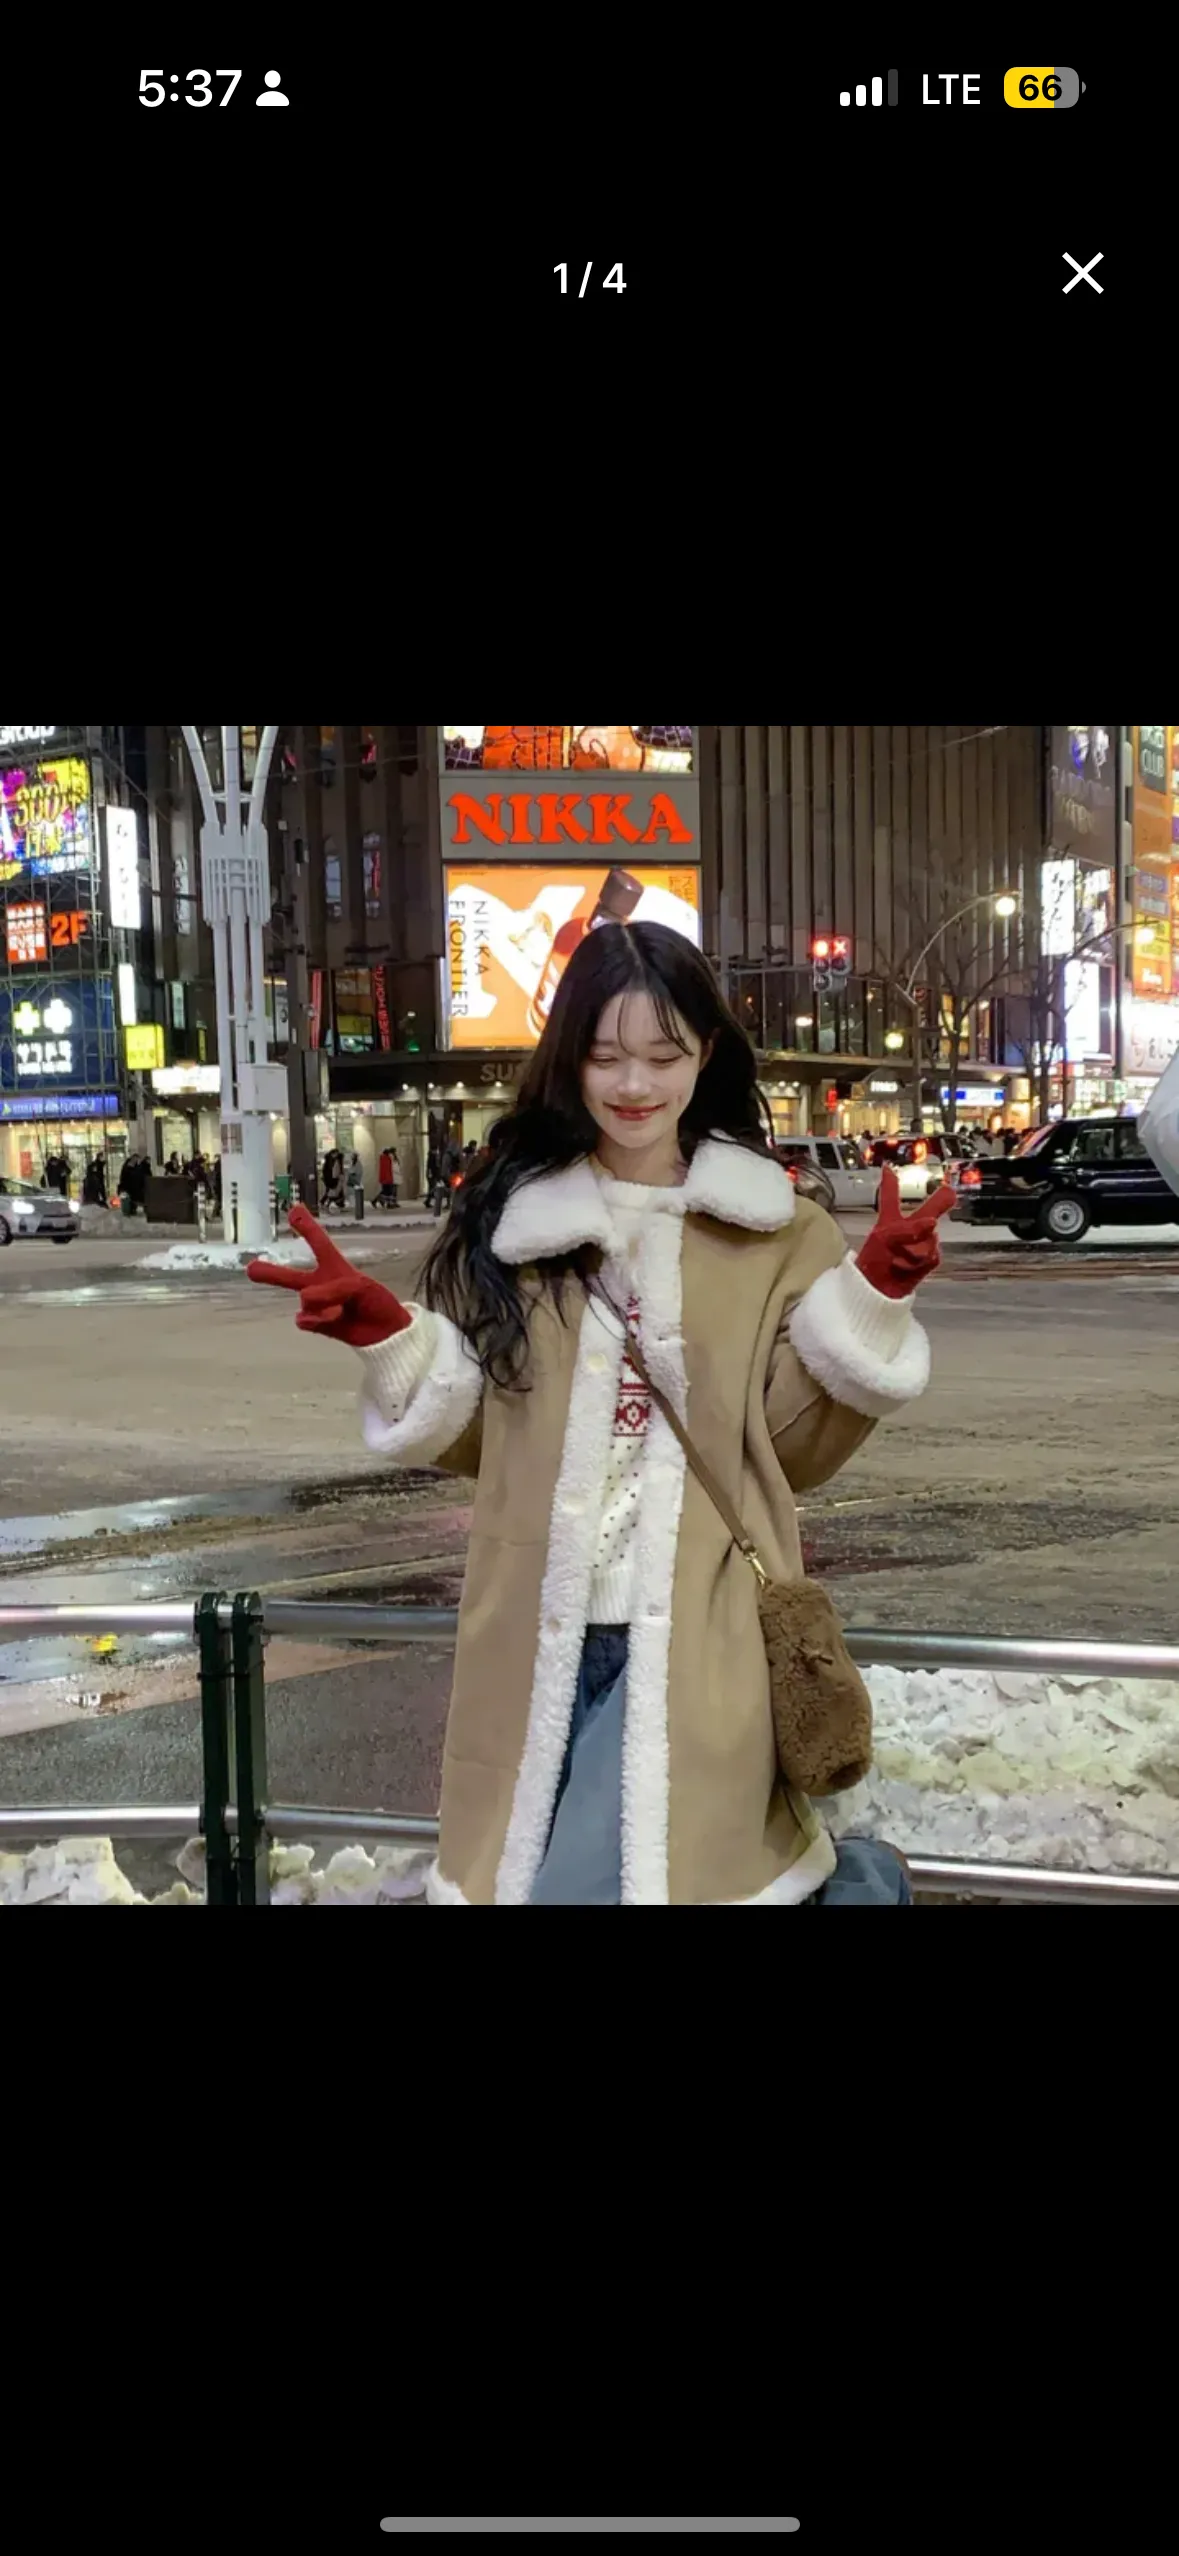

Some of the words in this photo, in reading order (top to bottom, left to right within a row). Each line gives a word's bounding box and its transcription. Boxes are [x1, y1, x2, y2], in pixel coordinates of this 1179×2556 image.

[447, 792, 694, 845] NIKKA
[51, 911, 87, 947] 2F
[449, 900, 469, 1017] FRONTIER
[473, 900, 491, 976] NIKKA
